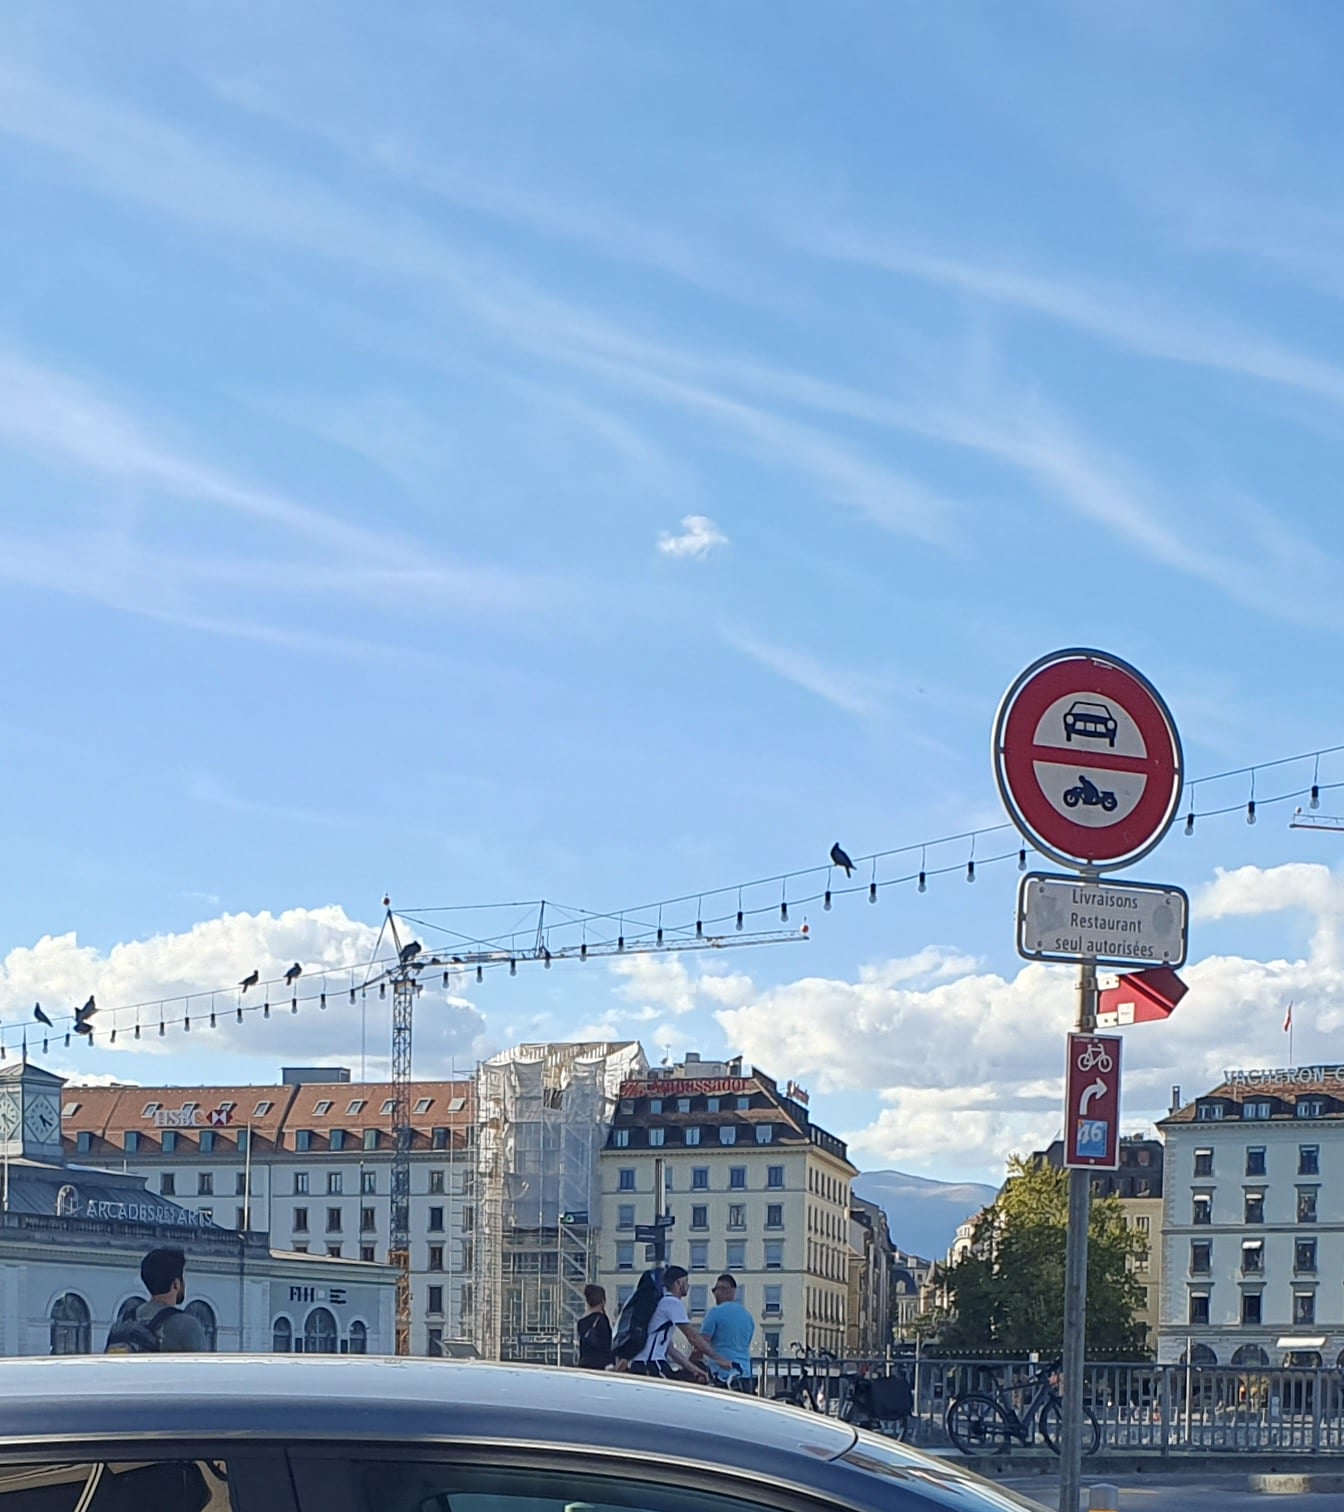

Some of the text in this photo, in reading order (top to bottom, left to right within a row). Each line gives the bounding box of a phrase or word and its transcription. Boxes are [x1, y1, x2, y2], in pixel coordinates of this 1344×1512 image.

[1072, 888, 1138, 910] Livraisons
[1070, 912, 1142, 934] Restaurant
[1055, 936, 1154, 958] seul autorisées
[1223, 1066, 1326, 1086] VACHERON
[156, 1109, 204, 1127] HSBC
[87, 1201, 156, 1222] ARCADES
[177, 1210, 213, 1227] ARTS
